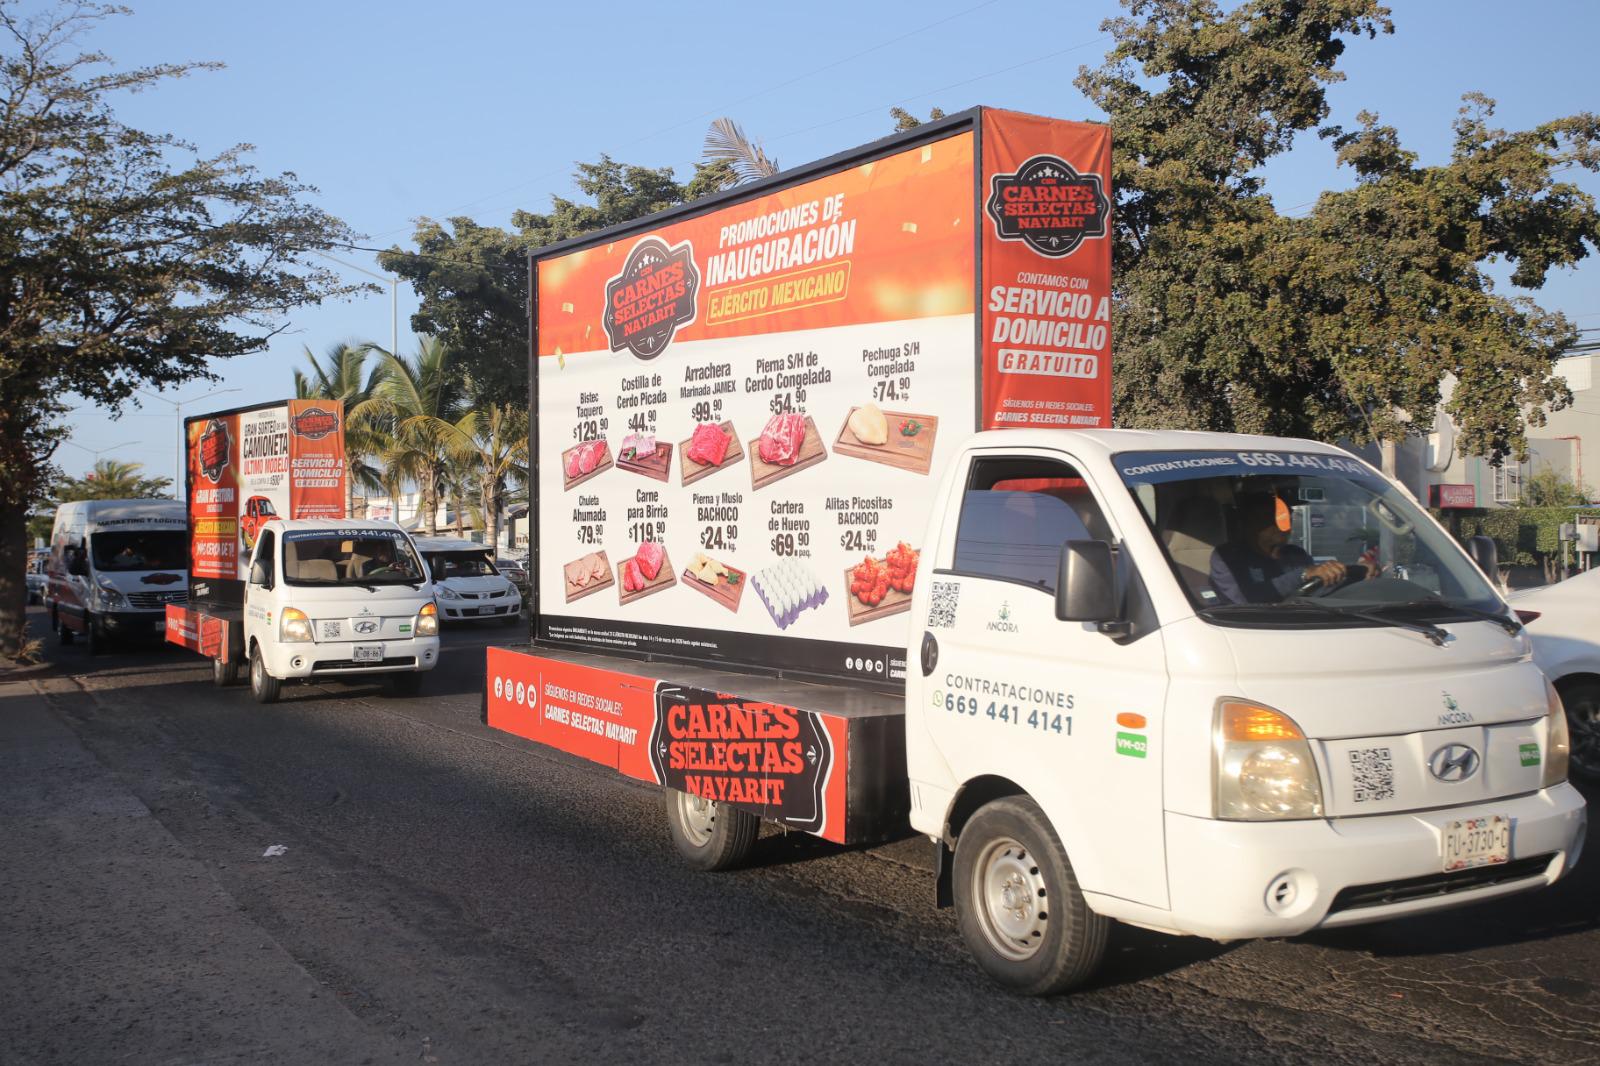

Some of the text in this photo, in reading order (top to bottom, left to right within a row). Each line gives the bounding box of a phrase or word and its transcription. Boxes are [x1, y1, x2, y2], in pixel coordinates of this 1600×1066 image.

[1003, 186, 1094, 202] CARNES
[1004, 202, 1096, 216] SELECTAS
[719, 193, 844, 248] PROMOCIONES DE
[1018, 217, 1085, 228] NAYARIT
[705, 215, 857, 288] INAUGURACIÓN
[613, 262, 684, 310] CARNES
[1017, 272, 1089, 290] CONTAMOS CON
[614, 280, 686, 326] SELECTAS
[710, 270, 846, 319] EJÉRCITO MEXICANO
[988, 286, 1110, 322] SERVICIO A
[624, 302, 676, 337] NAYARIT
[992, 316, 1107, 350] DOMICILIO
[862, 342, 920, 362] Pechuga S/H
[756, 350, 818, 374] Pierna S/H de
[868, 358, 915, 378] Congelada
[1002, 353, 1094, 374] GRATUITO
[684, 362, 732, 383] Arrachera
[745, 366, 832, 393] Cerdo Congelada
[621, 373, 662, 392] Costilla de
[680, 380, 736, 398] Marinada JAMEX
[580, 392, 599, 404] Bistec
[616, 390, 667, 409] Cerdo Picada
[1035, 400, 1045, 409] EN
[576, 405, 604, 418] Taquero
[994, 412, 1102, 426] CARNES SELECTAS NAYARIT
[244, 432, 288, 458] CAMIONETA
[265, 457, 288, 474] MODELO
[291, 458, 343, 468] SERVICIO A
[1123, 457, 1238, 476] CONTRATACIONES:
[292, 469, 342, 478] DOMICILIO
[578, 496, 600, 506] Chuleta
[636, 488, 659, 503] Carne
[692, 492, 743, 506] Pierna y Muslo
[825, 496, 893, 510] Alitas Picositas
[572, 508, 606, 522] Ahumada
[627, 504, 668, 521] para Birria
[697, 506, 739, 522] BACHOCO
[770, 500, 804, 515] Cartera
[768, 516, 810, 532] de Huevo
[838, 512, 879, 526] BACHOCO
[544, 681, 623, 717] SÍGUENOS EN REDES SOCIALES:
[945, 674, 1074, 710] CONTRATACIONES
[667, 702, 800, 740] CARNES
[945, 693, 1073, 736] 669 441 4141
[544, 704, 638, 746] CARNES SELECTAS NAYARIT
[669, 741, 806, 774] SELECTAS
[685, 774, 784, 806] NAYARIT
